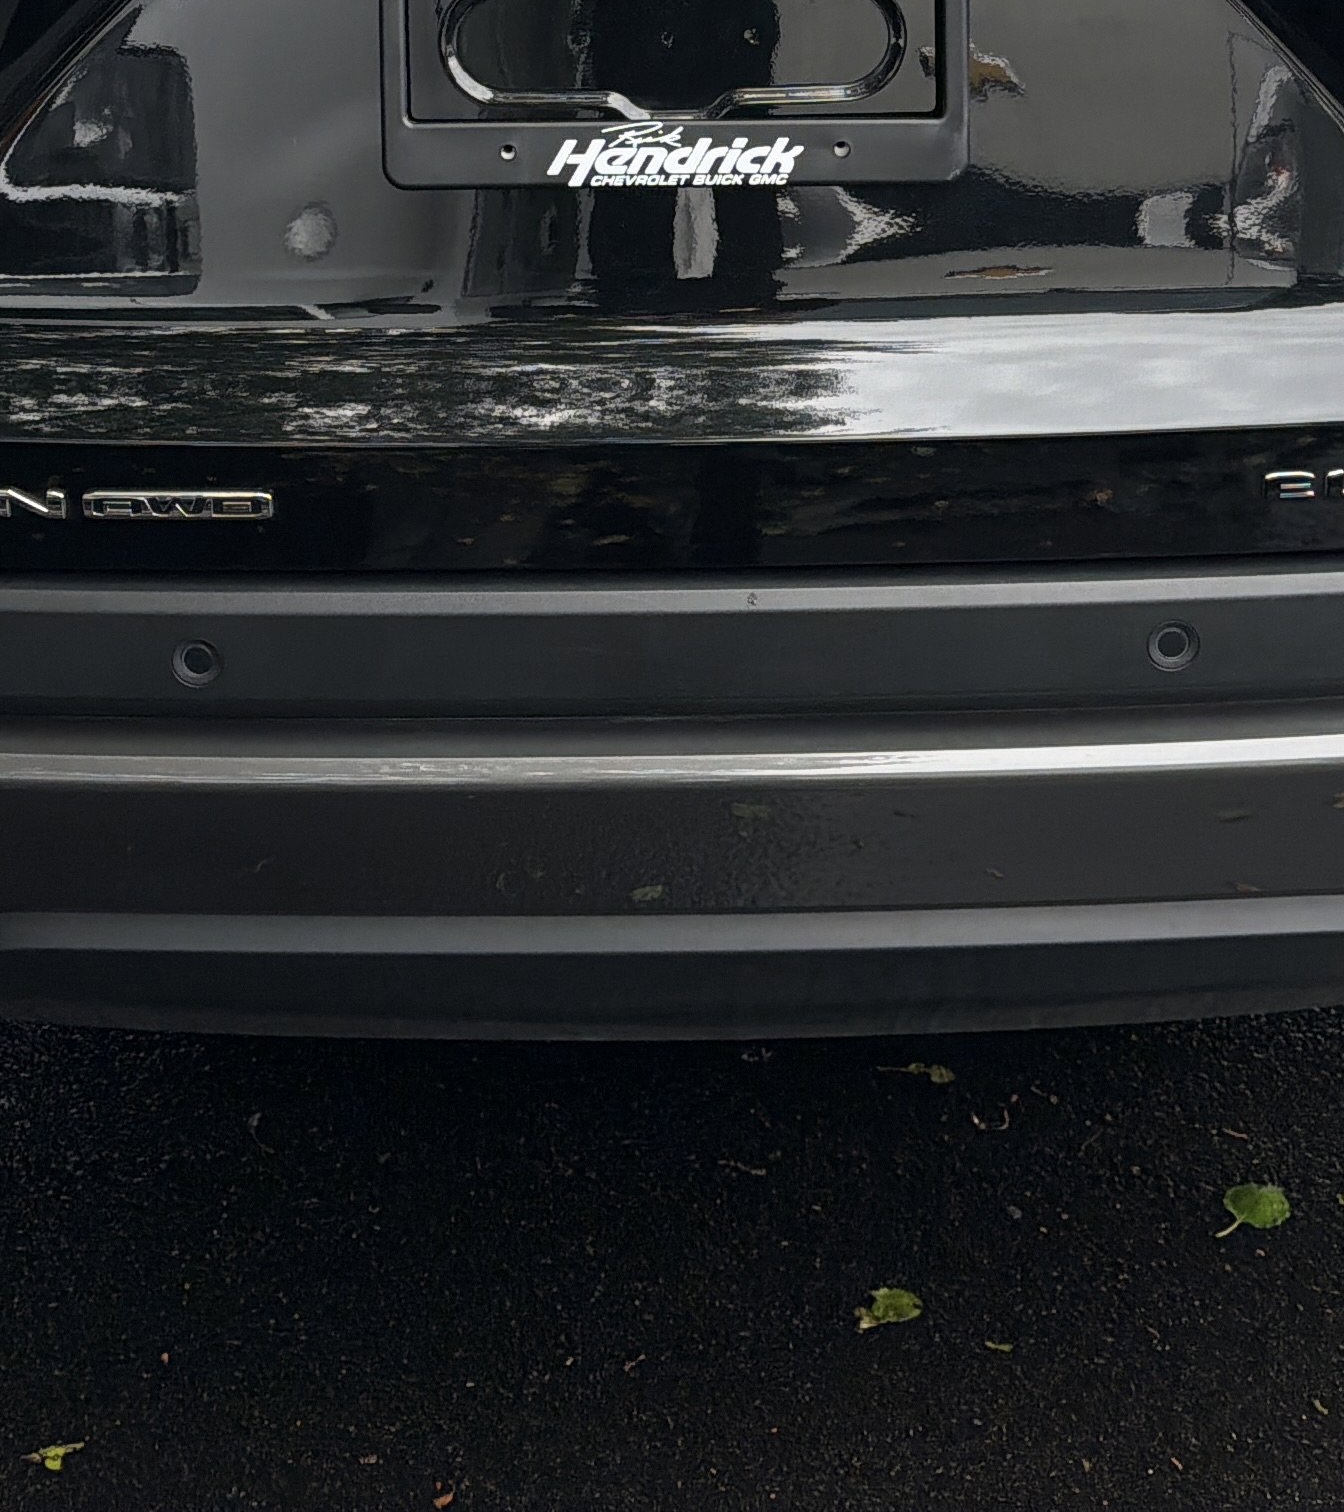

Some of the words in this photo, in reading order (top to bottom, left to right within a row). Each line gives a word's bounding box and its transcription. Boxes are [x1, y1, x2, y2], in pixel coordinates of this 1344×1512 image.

[546, 137, 805, 187] Hendrick
[590, 175, 690, 187] CHEVROLET
[692, 175, 745, 186] BUICK
[748, 174, 790, 186] GMC
[82, 490, 274, 520] AWD
